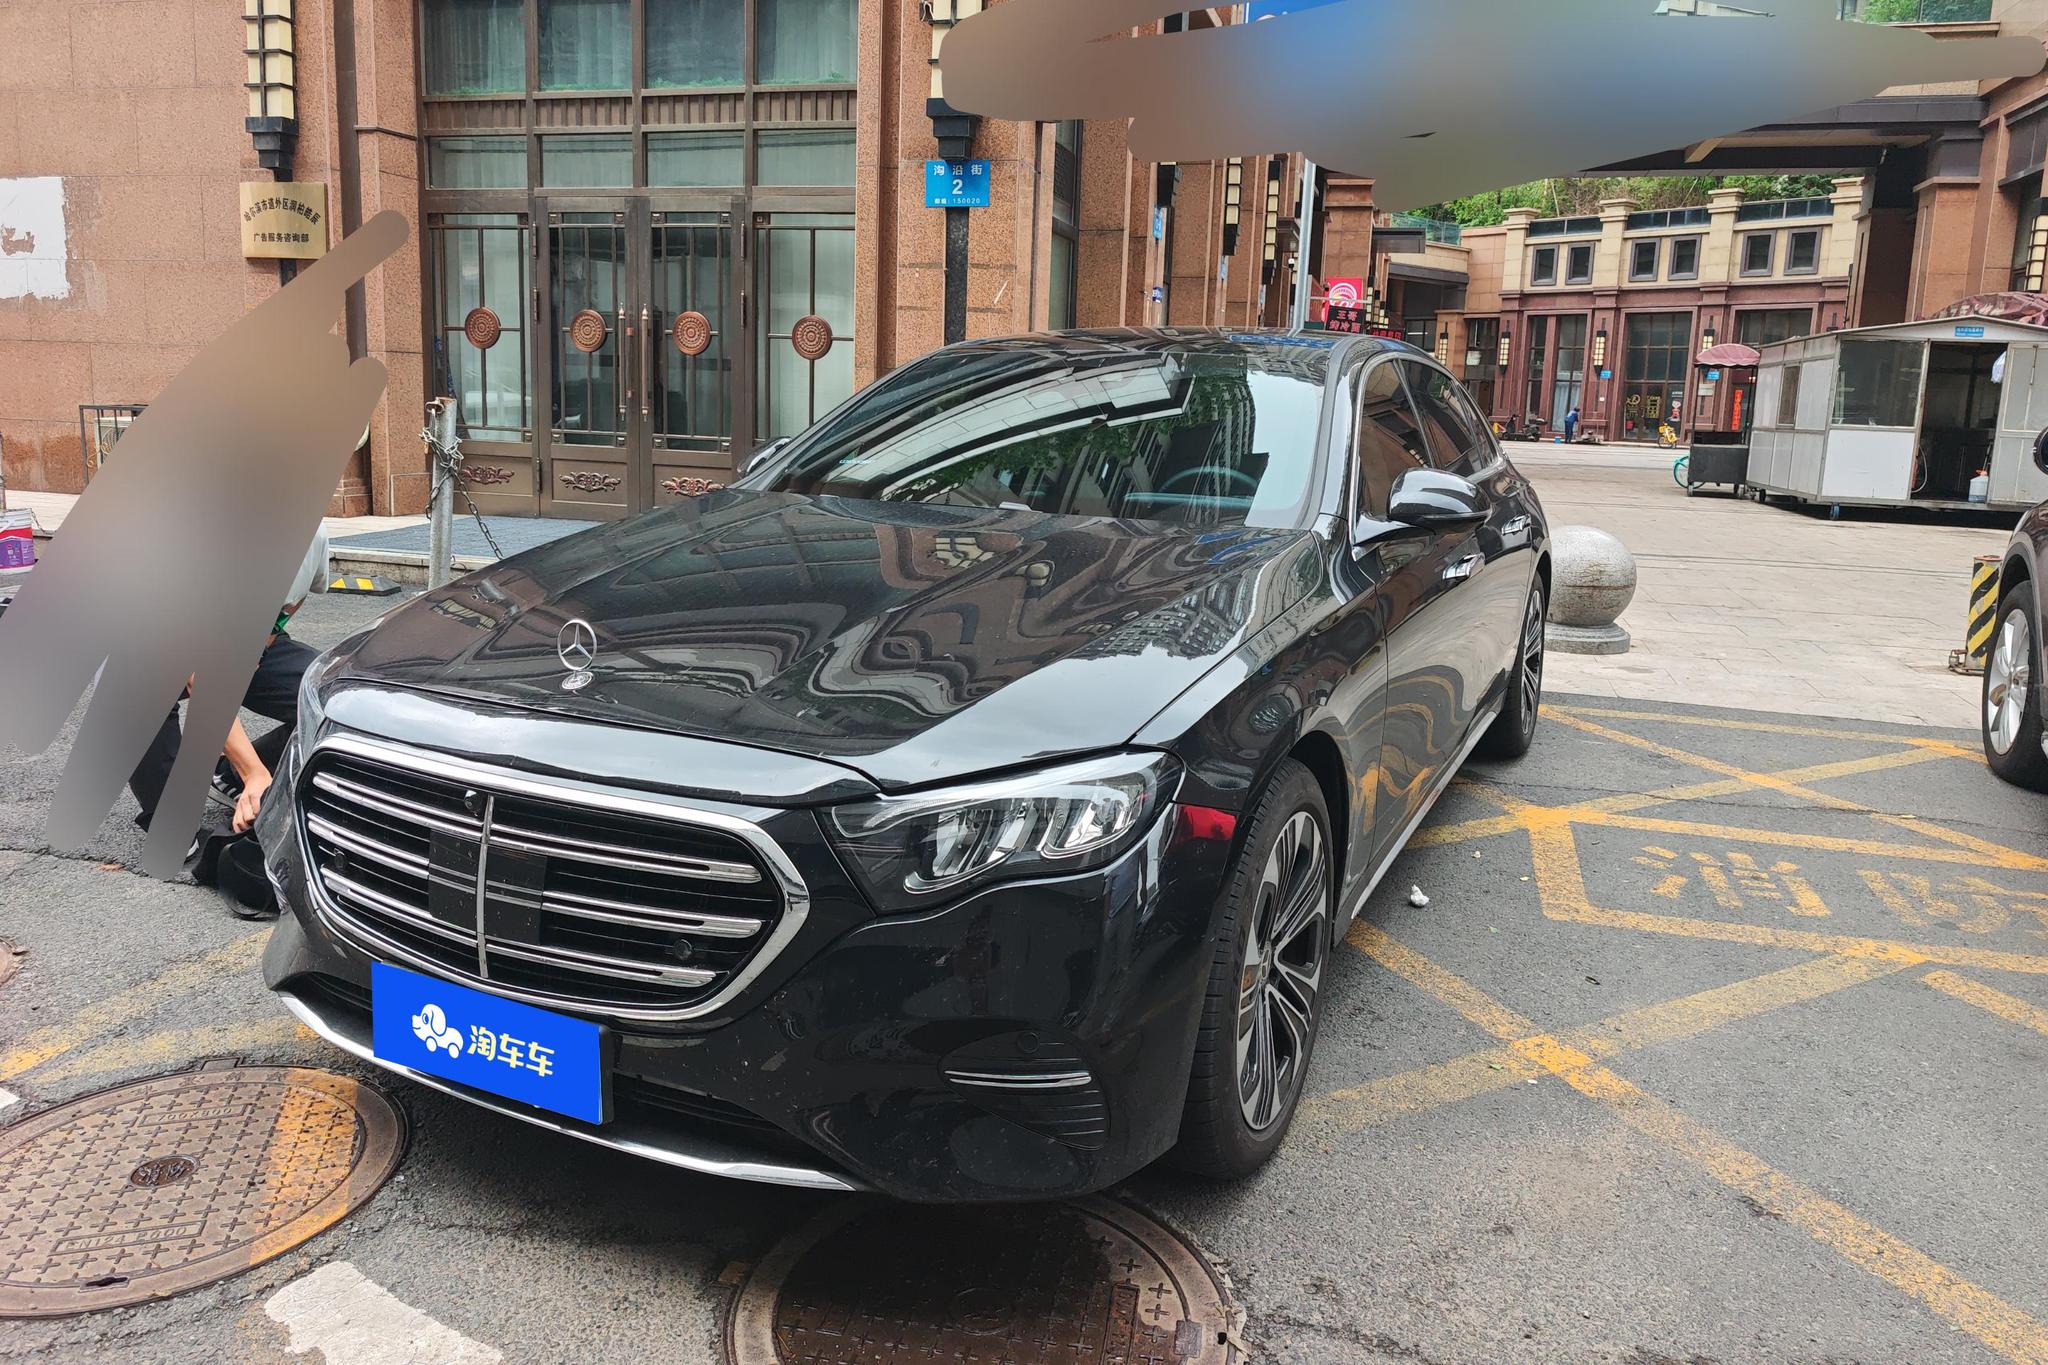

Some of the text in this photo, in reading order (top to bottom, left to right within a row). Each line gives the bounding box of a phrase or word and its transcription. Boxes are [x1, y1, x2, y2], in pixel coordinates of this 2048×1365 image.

[952, 179, 963, 195] 2
[253, 232, 310, 243] 广告服务咨询部
